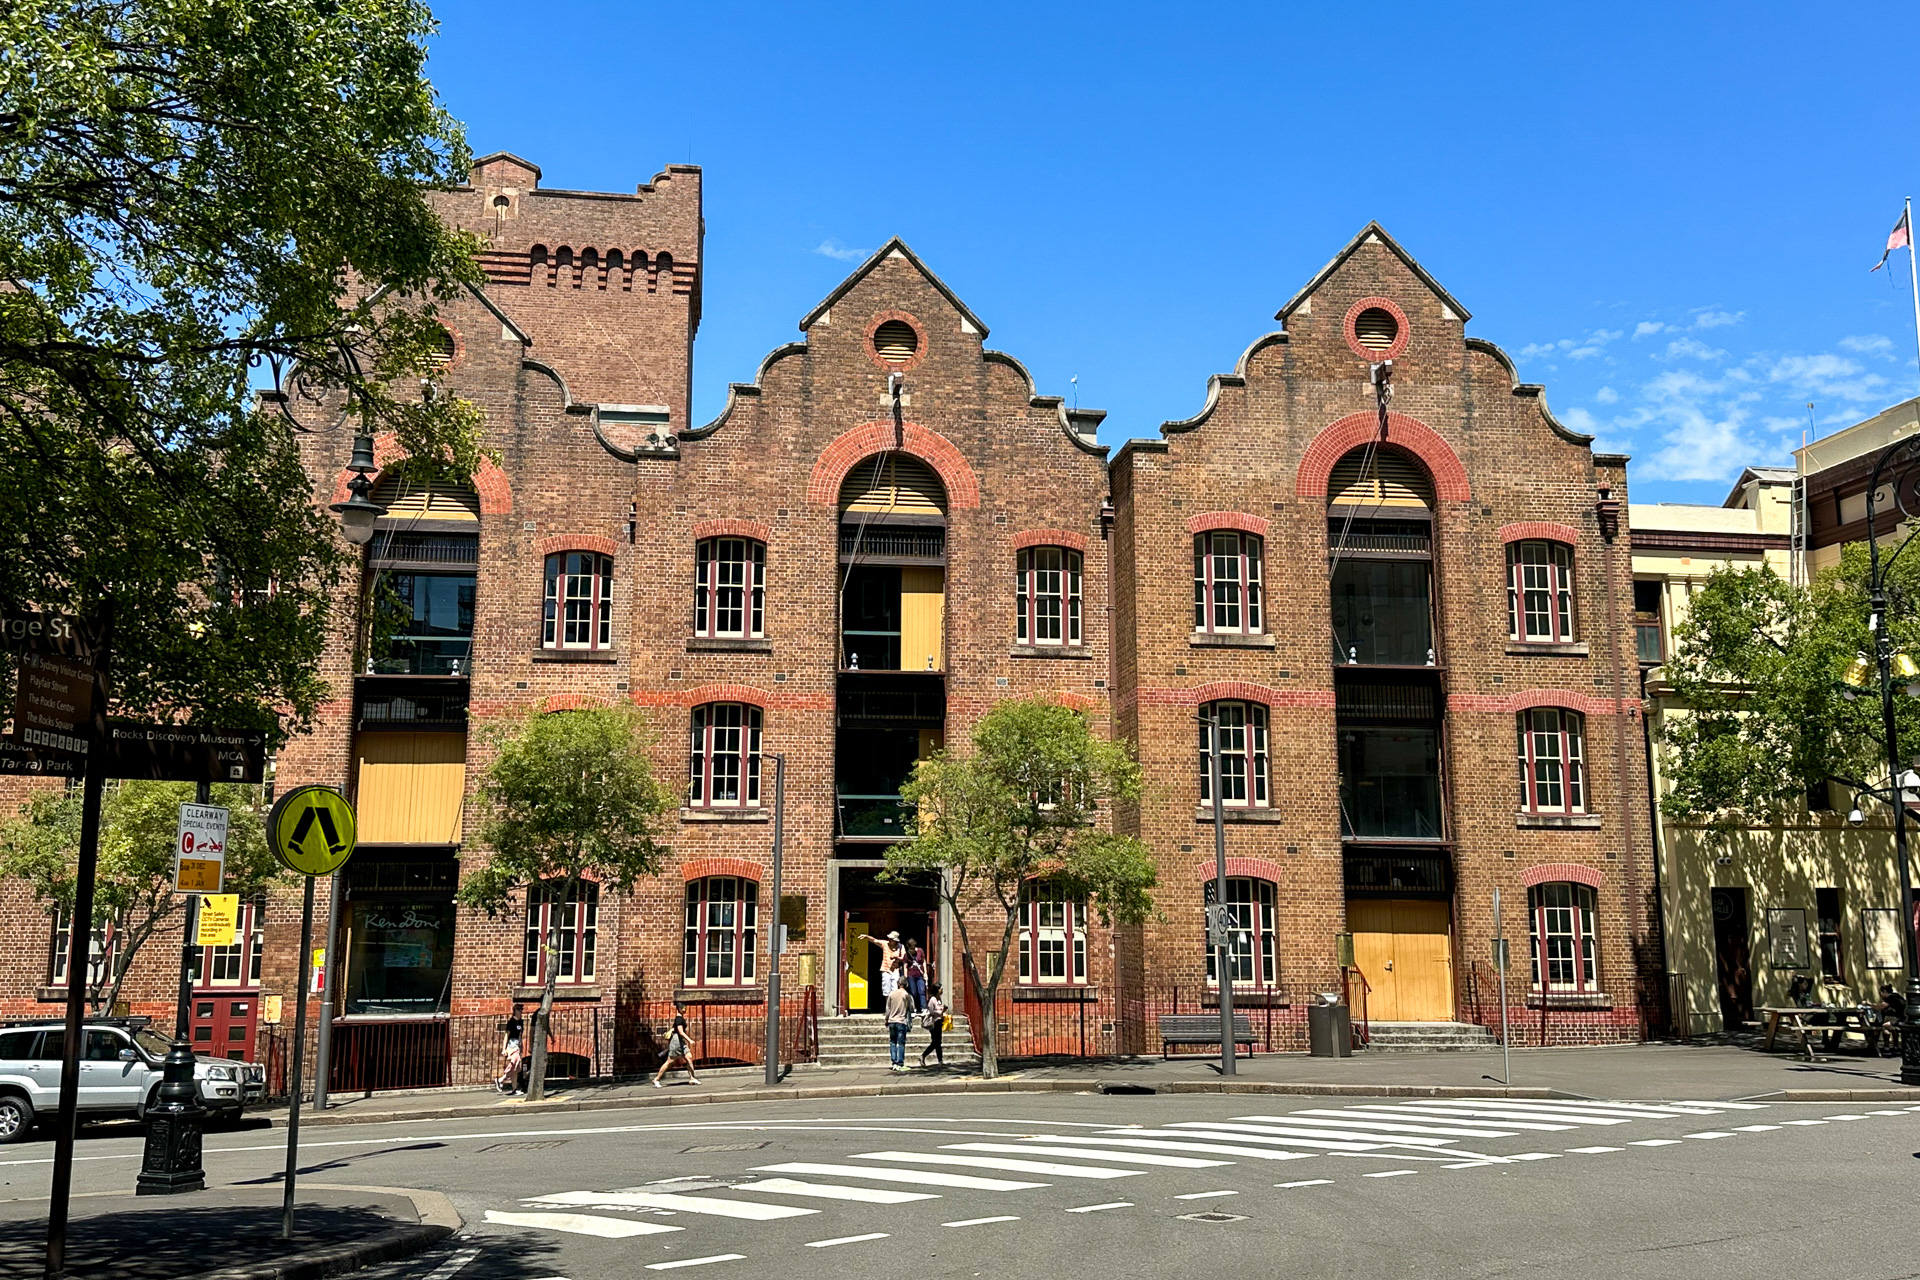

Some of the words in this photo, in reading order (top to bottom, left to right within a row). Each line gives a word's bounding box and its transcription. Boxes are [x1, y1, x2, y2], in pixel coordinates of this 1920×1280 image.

[50, 618, 73, 639] St
[40, 658, 60, 675] Sydney
[60, 664, 77, 678] Visitor
[78, 670, 94, 684] Centre
[30, 674, 51, 689] Playfair
[52, 680, 68, 694] Street
[29, 692, 39, 705] The
[40, 696, 56, 709] Rocks
[56, 700, 75, 713] Centre
[26, 711, 37, 723] The
[38, 714, 55, 727] Rocks
[55, 718, 74, 731] Square
[112, 728, 144, 740] Rocks
[146, 730, 197, 745] Discovery
[200, 734, 245, 744] Museum
[46, 760, 73, 771] Park
[218, 751, 244, 761] MCA
[187, 809, 224, 821] CLEARWAY
[183, 820, 204, 829] SPECIAL
[206, 822, 225, 830] EVENTS
[365, 913, 397, 929] Ken
[399, 910, 440, 929] Done
